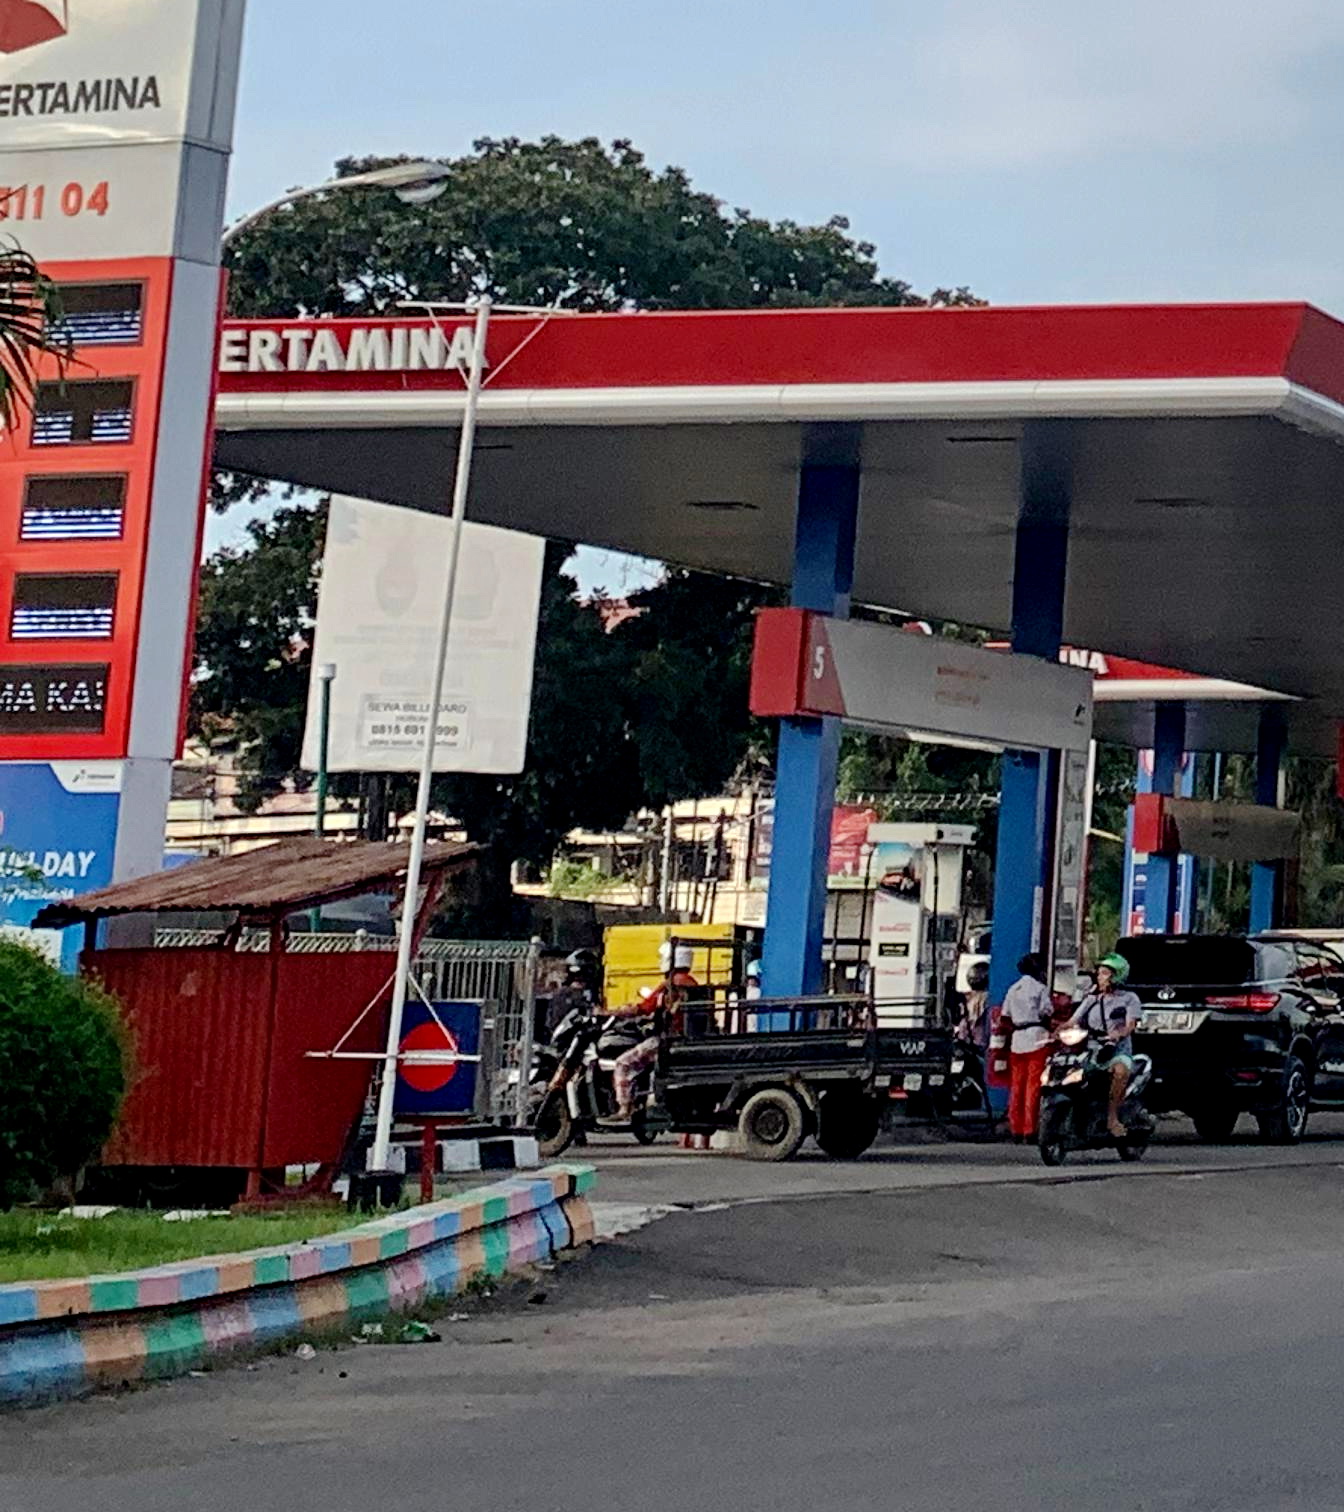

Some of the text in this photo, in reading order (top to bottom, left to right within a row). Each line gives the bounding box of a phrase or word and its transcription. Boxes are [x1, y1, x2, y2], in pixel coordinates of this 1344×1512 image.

[61, 181, 109, 217] 04
[218, 326, 489, 372] ERTAMINA
[813, 646, 825, 679] 5
[43, 850, 96, 878] DAY
